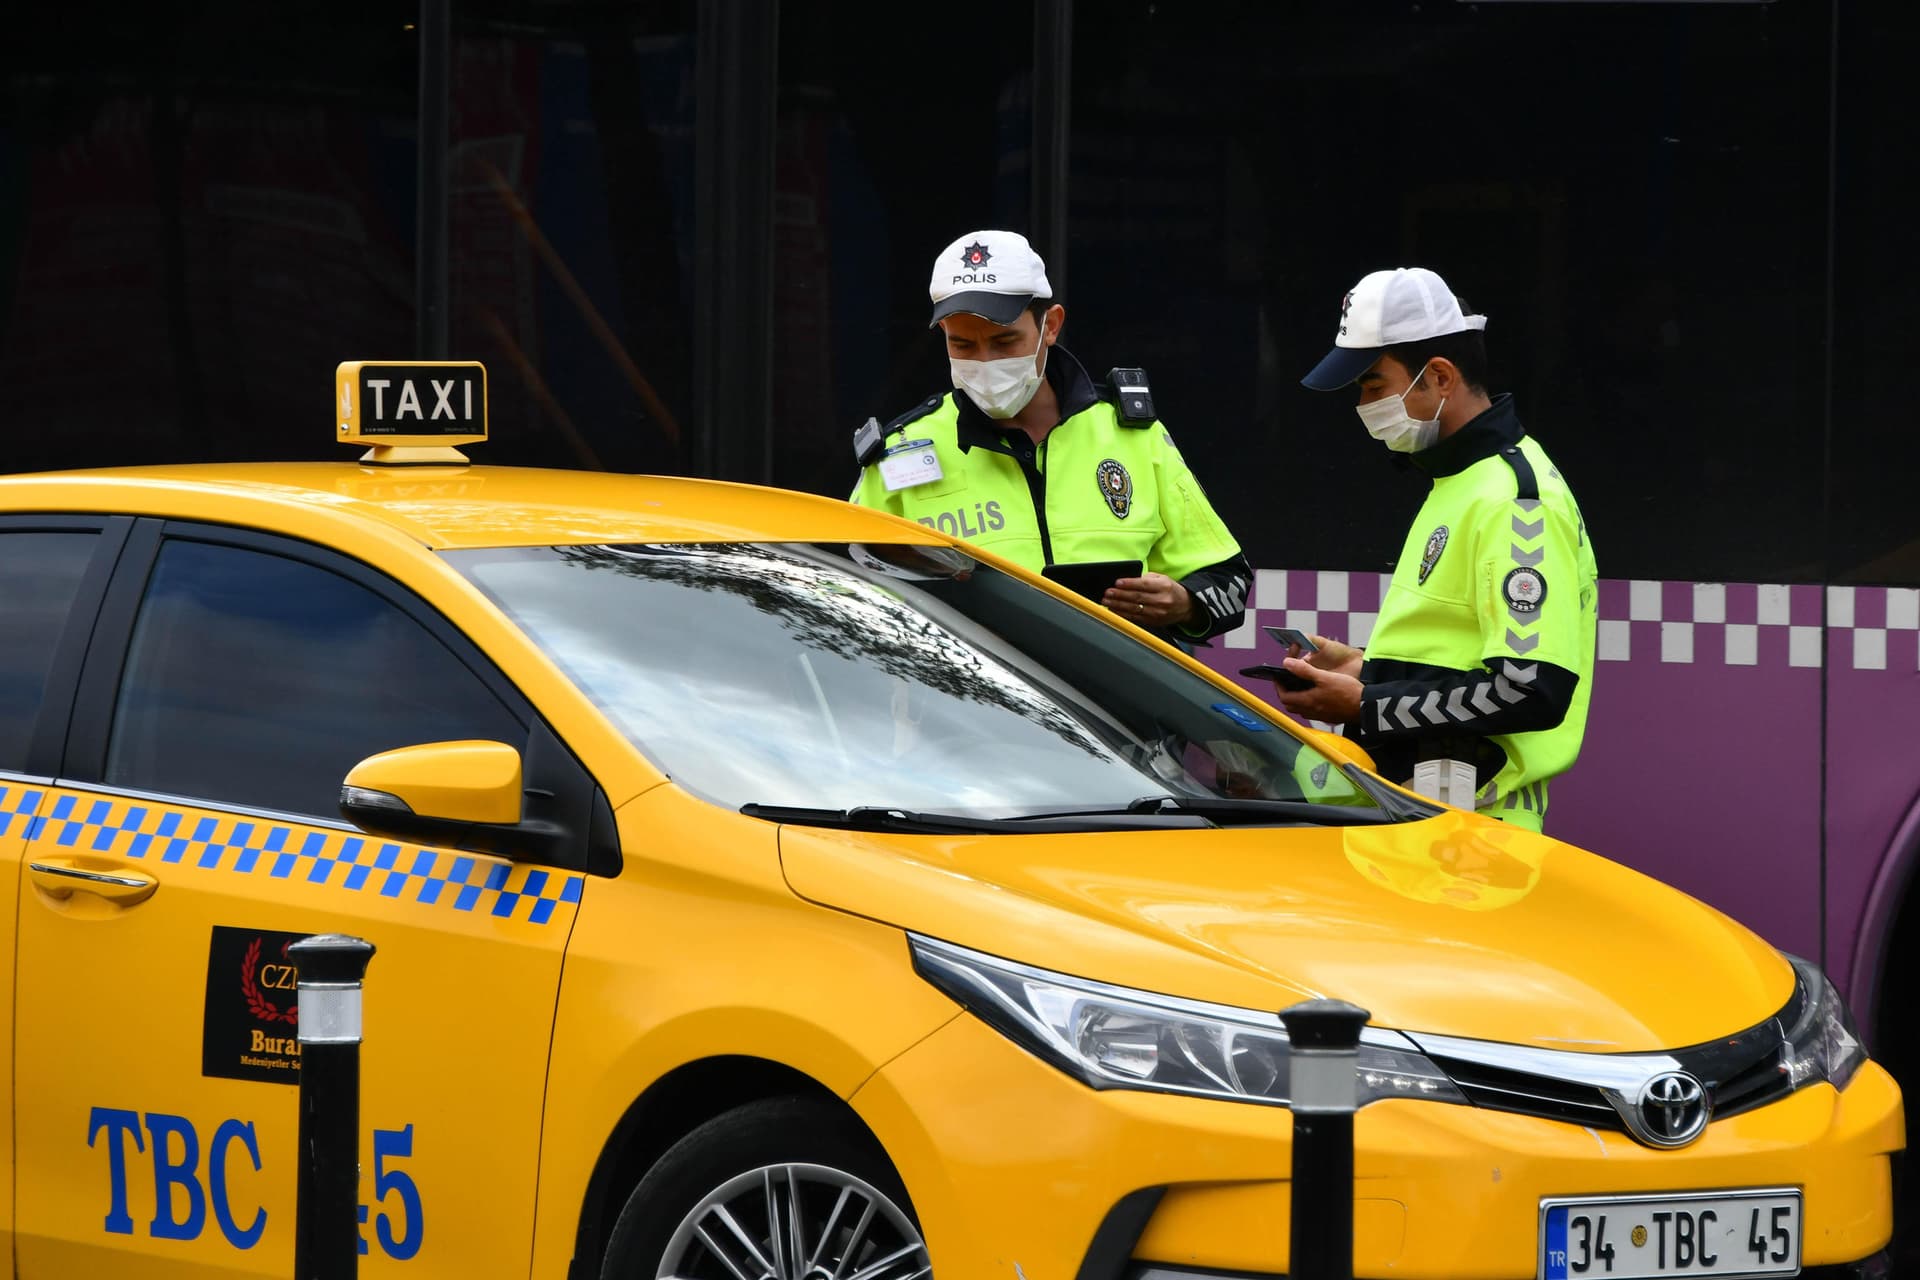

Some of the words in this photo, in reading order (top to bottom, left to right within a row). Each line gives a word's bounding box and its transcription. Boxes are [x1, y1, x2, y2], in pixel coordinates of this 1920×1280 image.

[367, 379, 473, 420] TAXI
[88, 1106, 267, 1250] TBC
[357, 1123, 424, 1261] 5
[1549, 1251, 1566, 1268] TR
[1571, 1215, 1615, 1273] 34
[1652, 1210, 1718, 1269] TBC
[1748, 1206, 1791, 1264] 45
